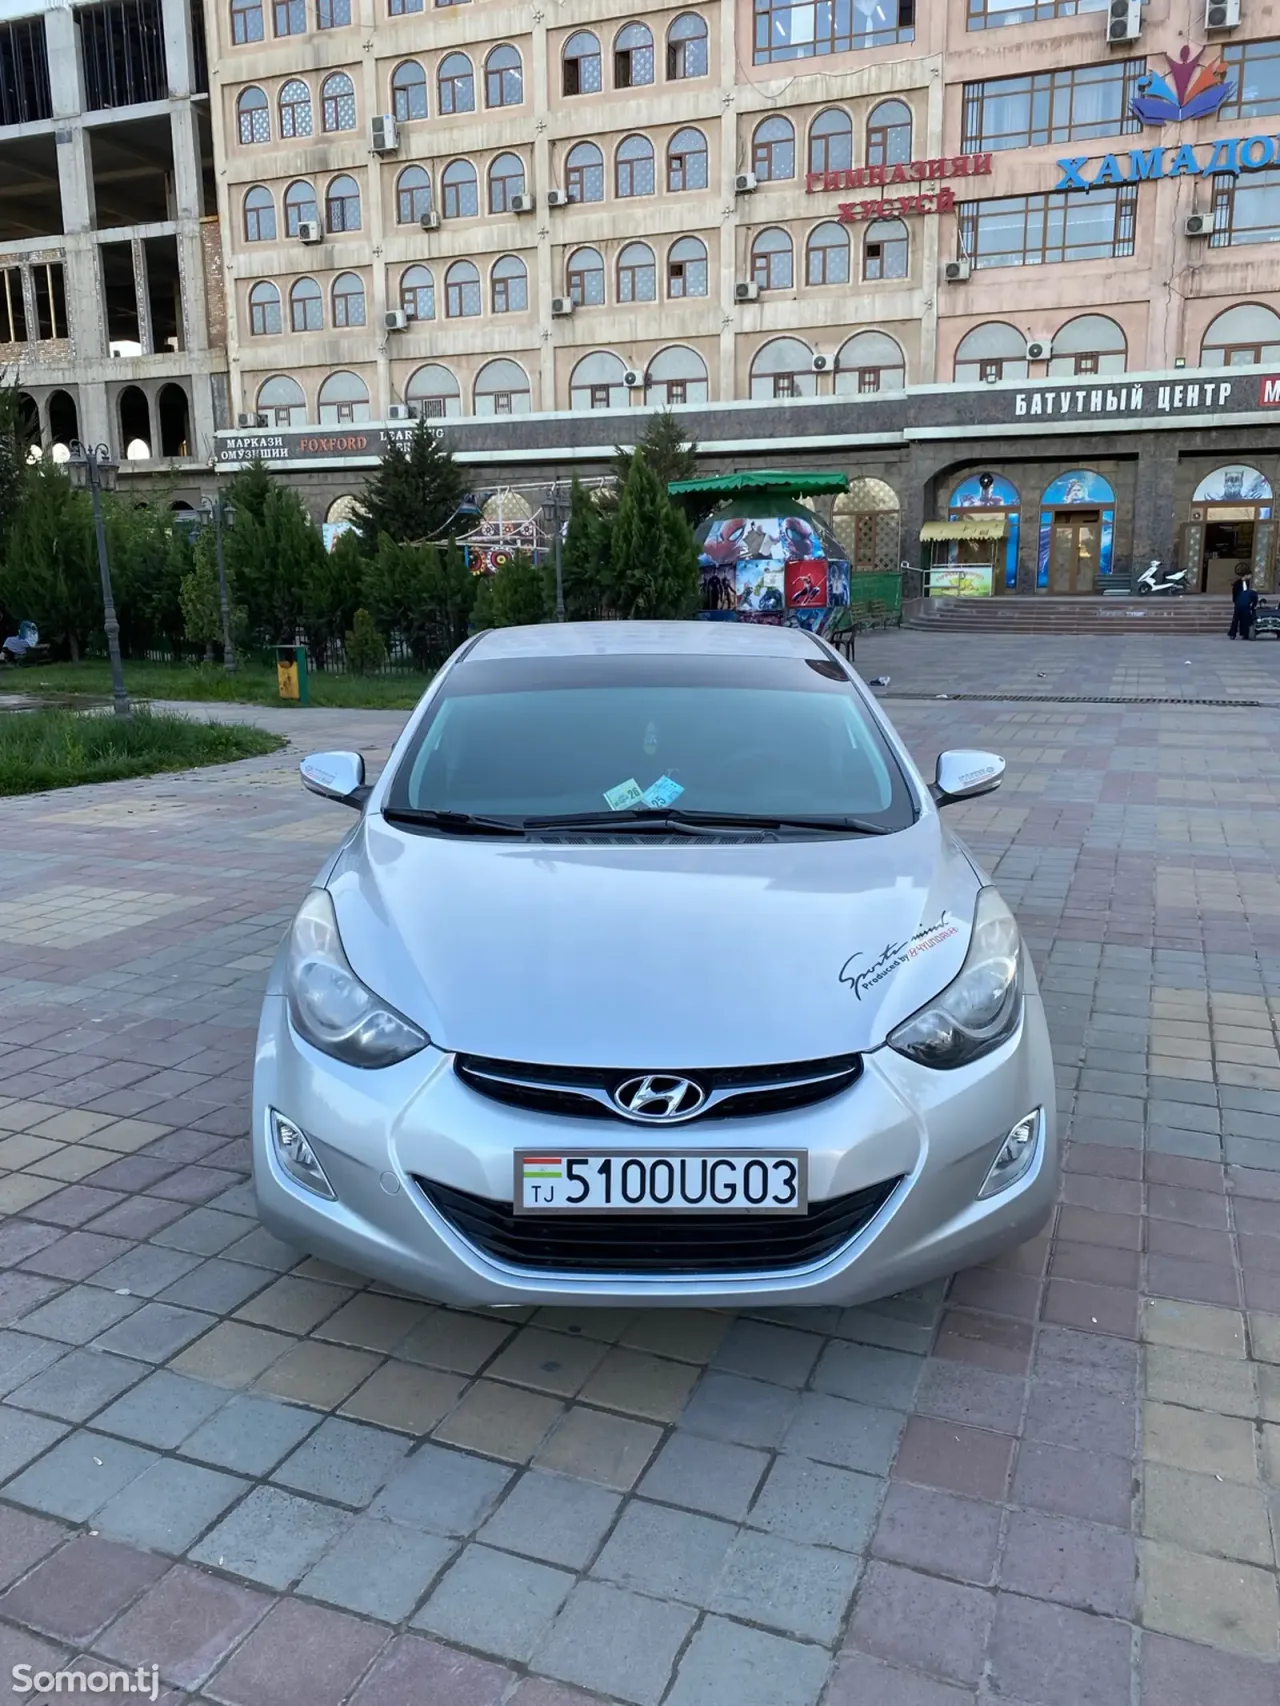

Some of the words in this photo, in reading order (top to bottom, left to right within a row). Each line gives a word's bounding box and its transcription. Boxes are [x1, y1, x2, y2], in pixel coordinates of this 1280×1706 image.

[805, 153, 993, 194] ГИМНАЗИЯИ
[1056, 133, 1280, 190] ҲАМАДО
[1015, 384, 1143, 416] БАТУТНЫЙ
[1157, 383, 1232, 411] ЦЕНТР
[226, 437, 283, 449] МАРКАЗИ
[300, 436, 368, 452] FOXFORD
[627, 787, 641, 800] 26
[861, 959, 901, 990] Produced
[531, 1185, 554, 1203] TJ
[565, 1158, 797, 1204] 5100UG03
